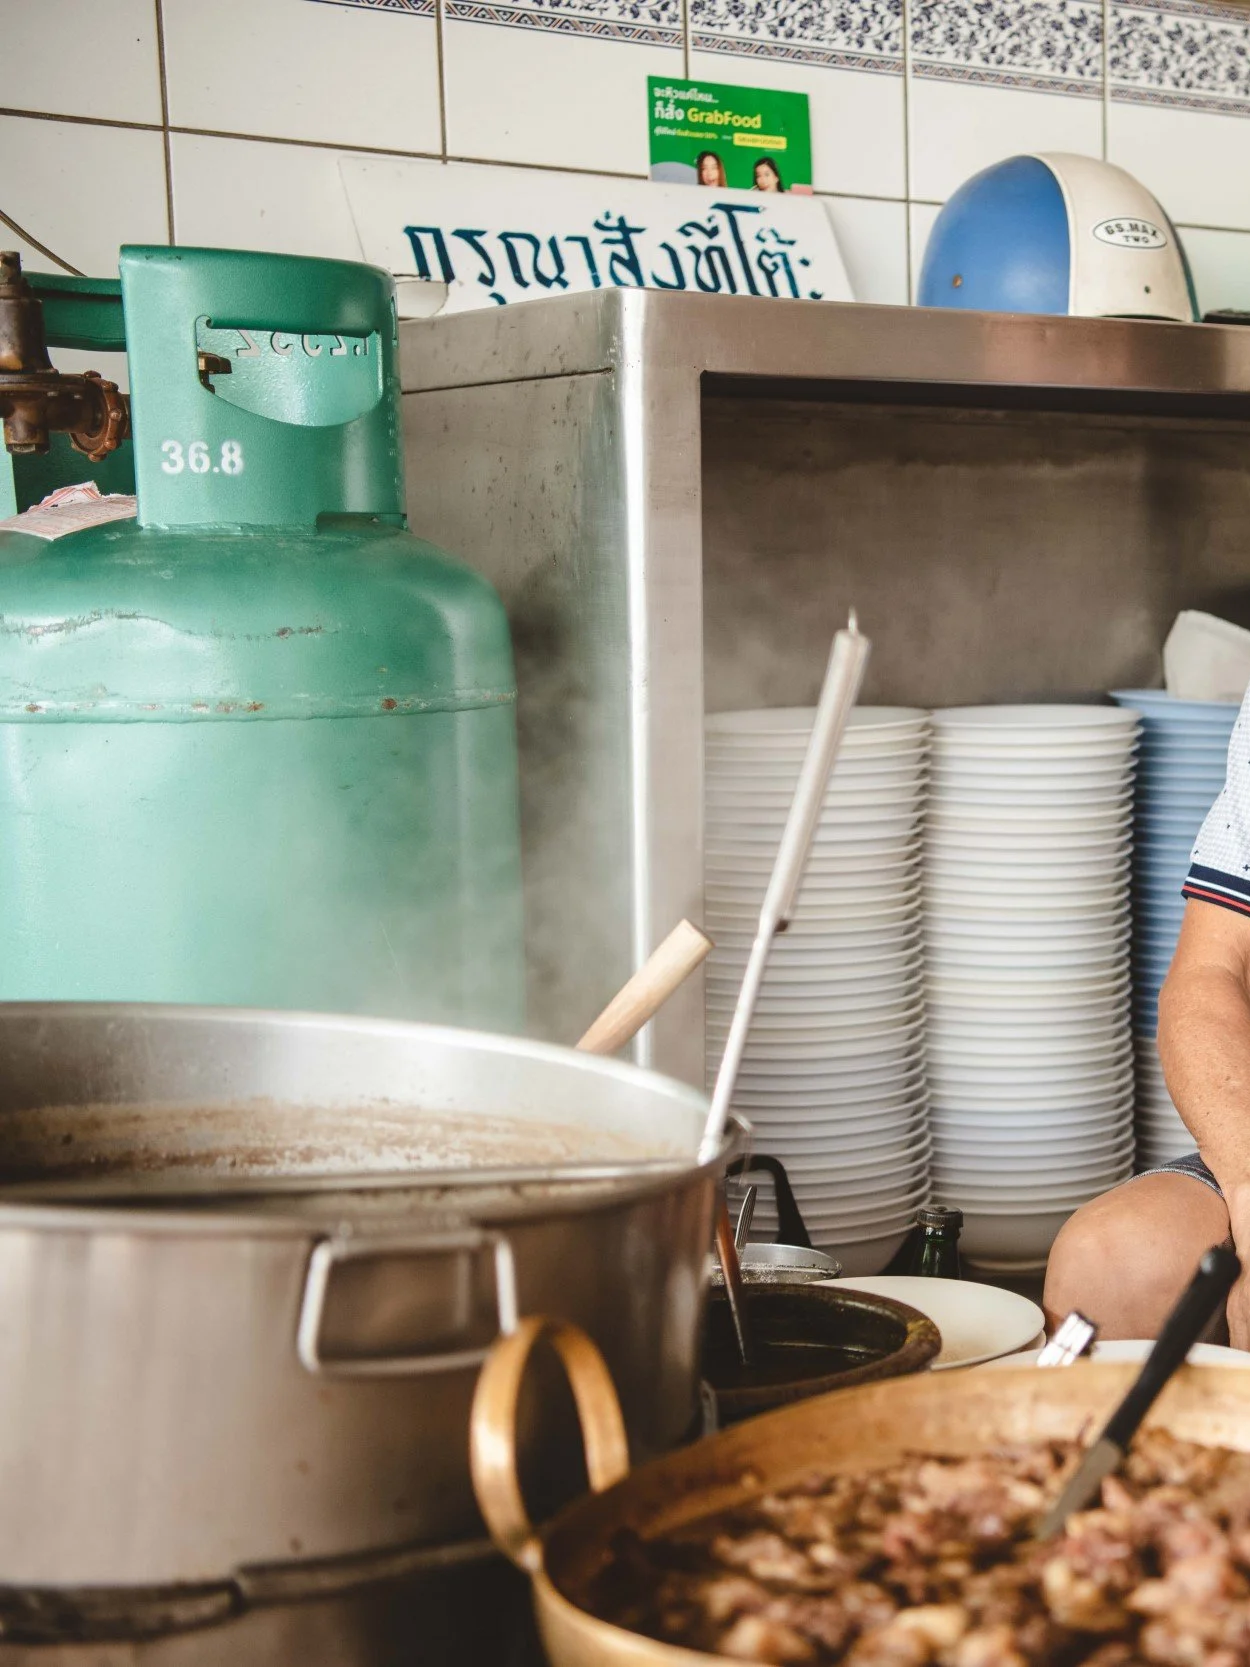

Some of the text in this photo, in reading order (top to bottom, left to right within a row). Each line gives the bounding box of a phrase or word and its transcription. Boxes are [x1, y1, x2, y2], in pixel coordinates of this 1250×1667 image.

[686, 107, 762, 129] GrabFood
[1105, 223, 1159, 239] GS.MAX
[1124, 235, 1150, 243] TWO
[161, 440, 244, 475] 36.8
